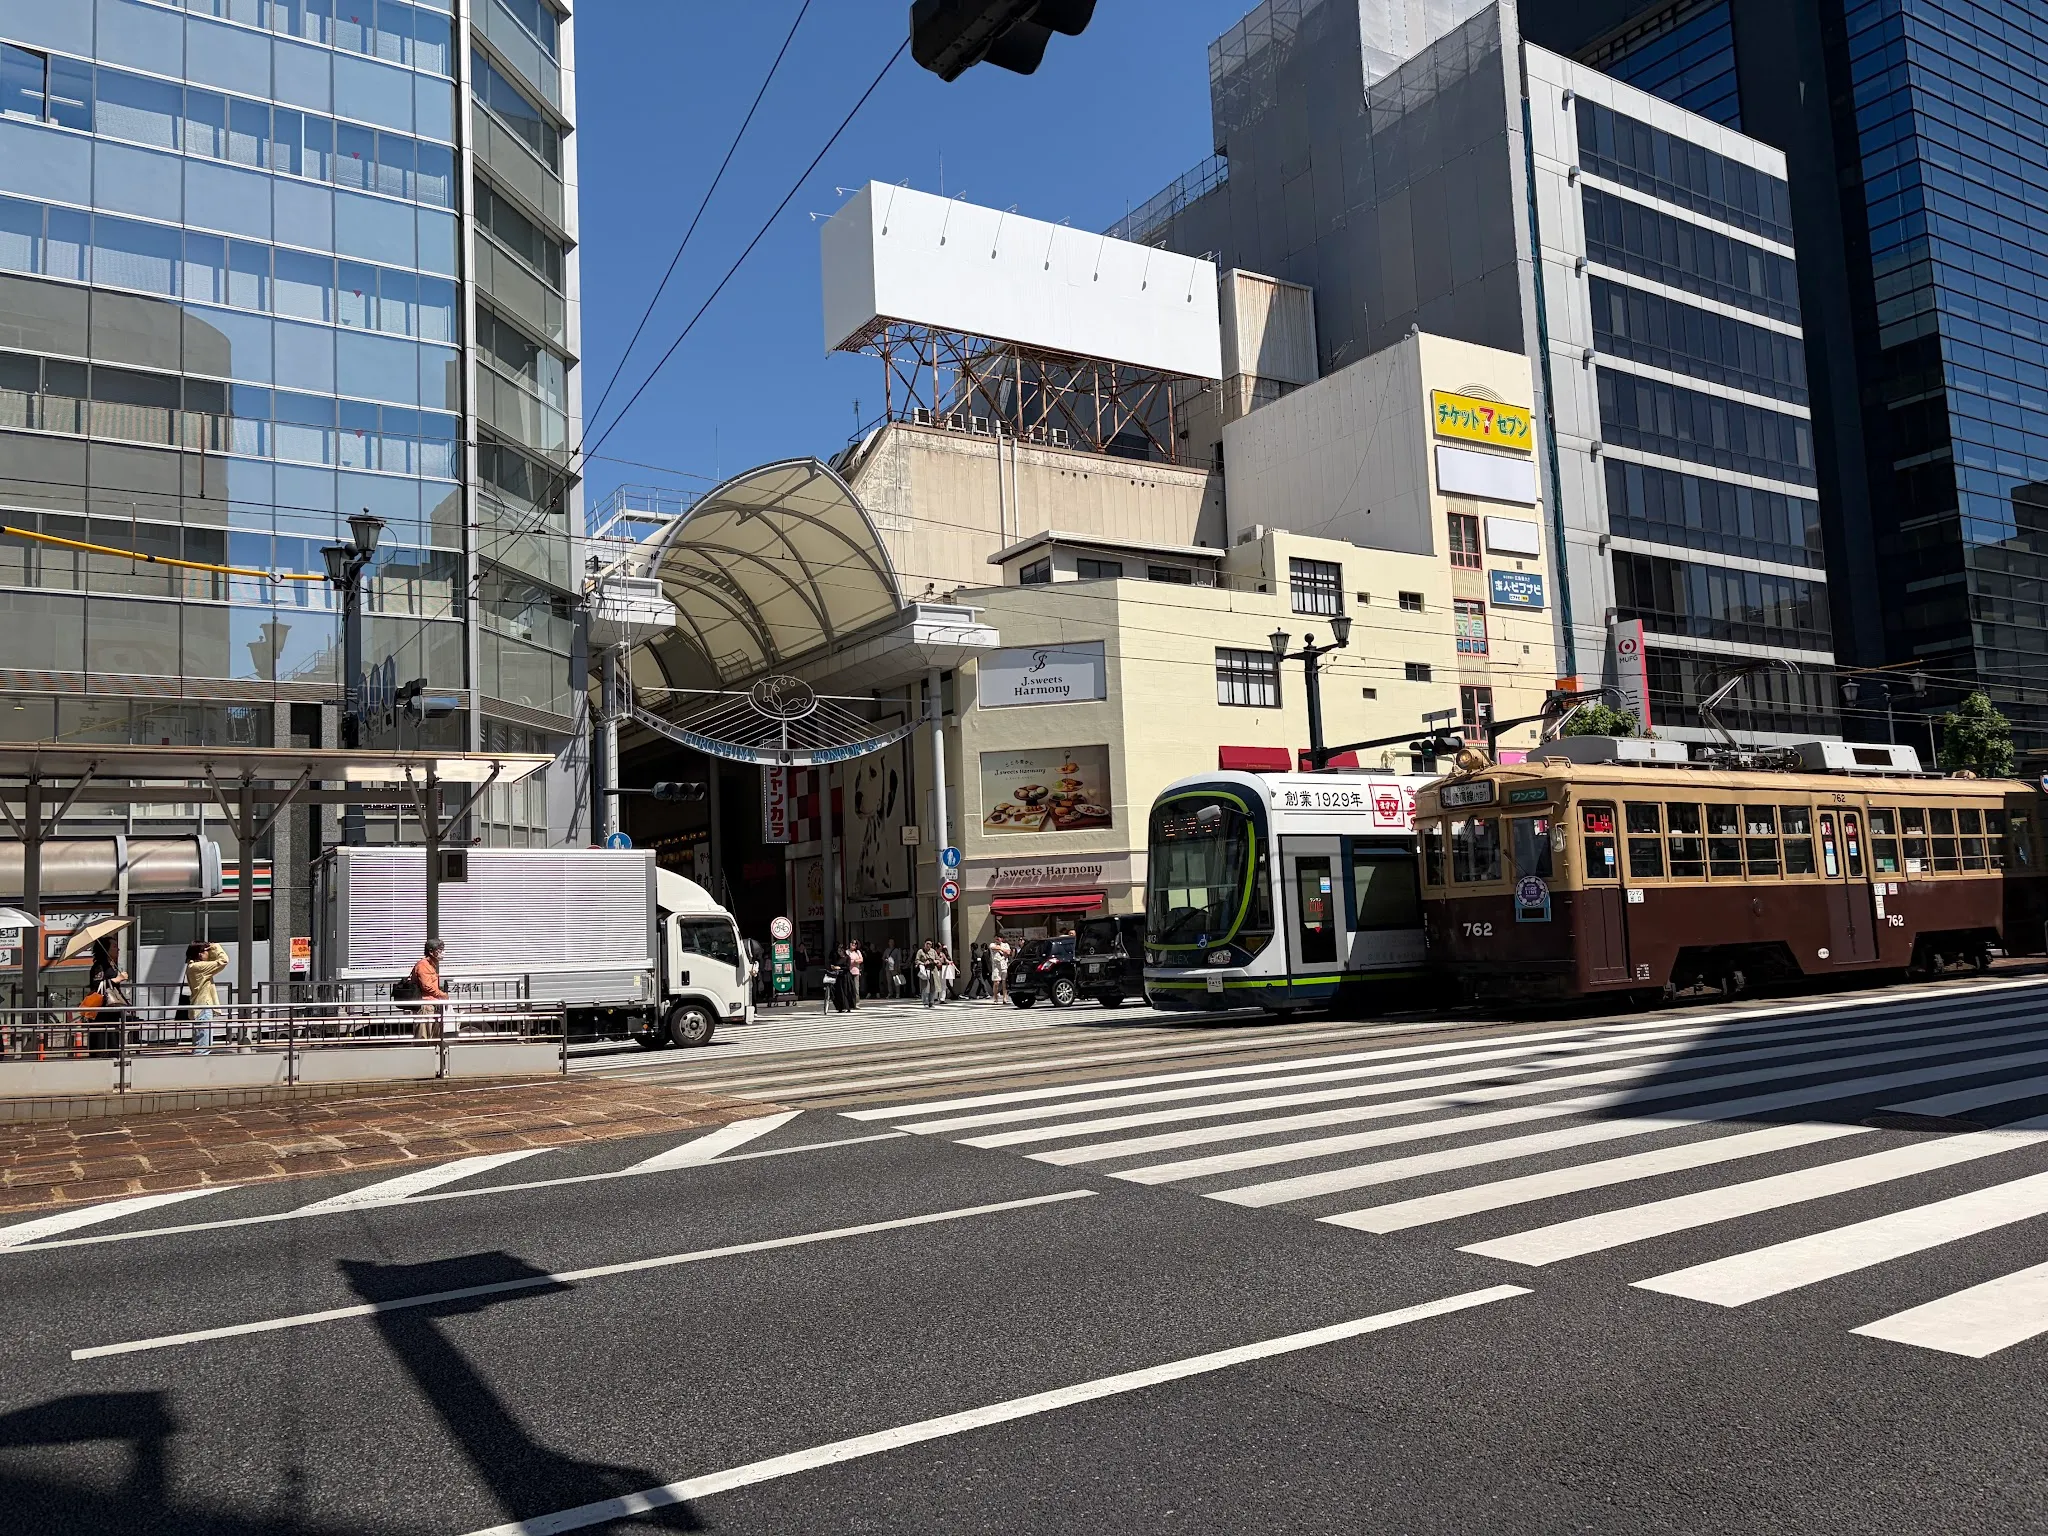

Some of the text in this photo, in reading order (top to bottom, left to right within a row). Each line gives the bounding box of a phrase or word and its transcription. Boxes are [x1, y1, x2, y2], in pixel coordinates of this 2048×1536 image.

[1619, 655, 1639, 664] MUFG
[1020, 676, 1063, 687] J.sweets
[1014, 685, 1070, 697] Harmony
[684, 733, 758, 762] HIROSHIMA
[812, 744, 864, 764] HONDORI
[1284, 791, 1364, 808] 創業1929年
[1512, 790, 1546, 801] ワンマン
[1831, 793, 1846, 803] 762
[991, 864, 1102, 879] J.sweets Harmony
[1886, 914, 1905, 927] 762
[1462, 922, 1493, 937] 762
